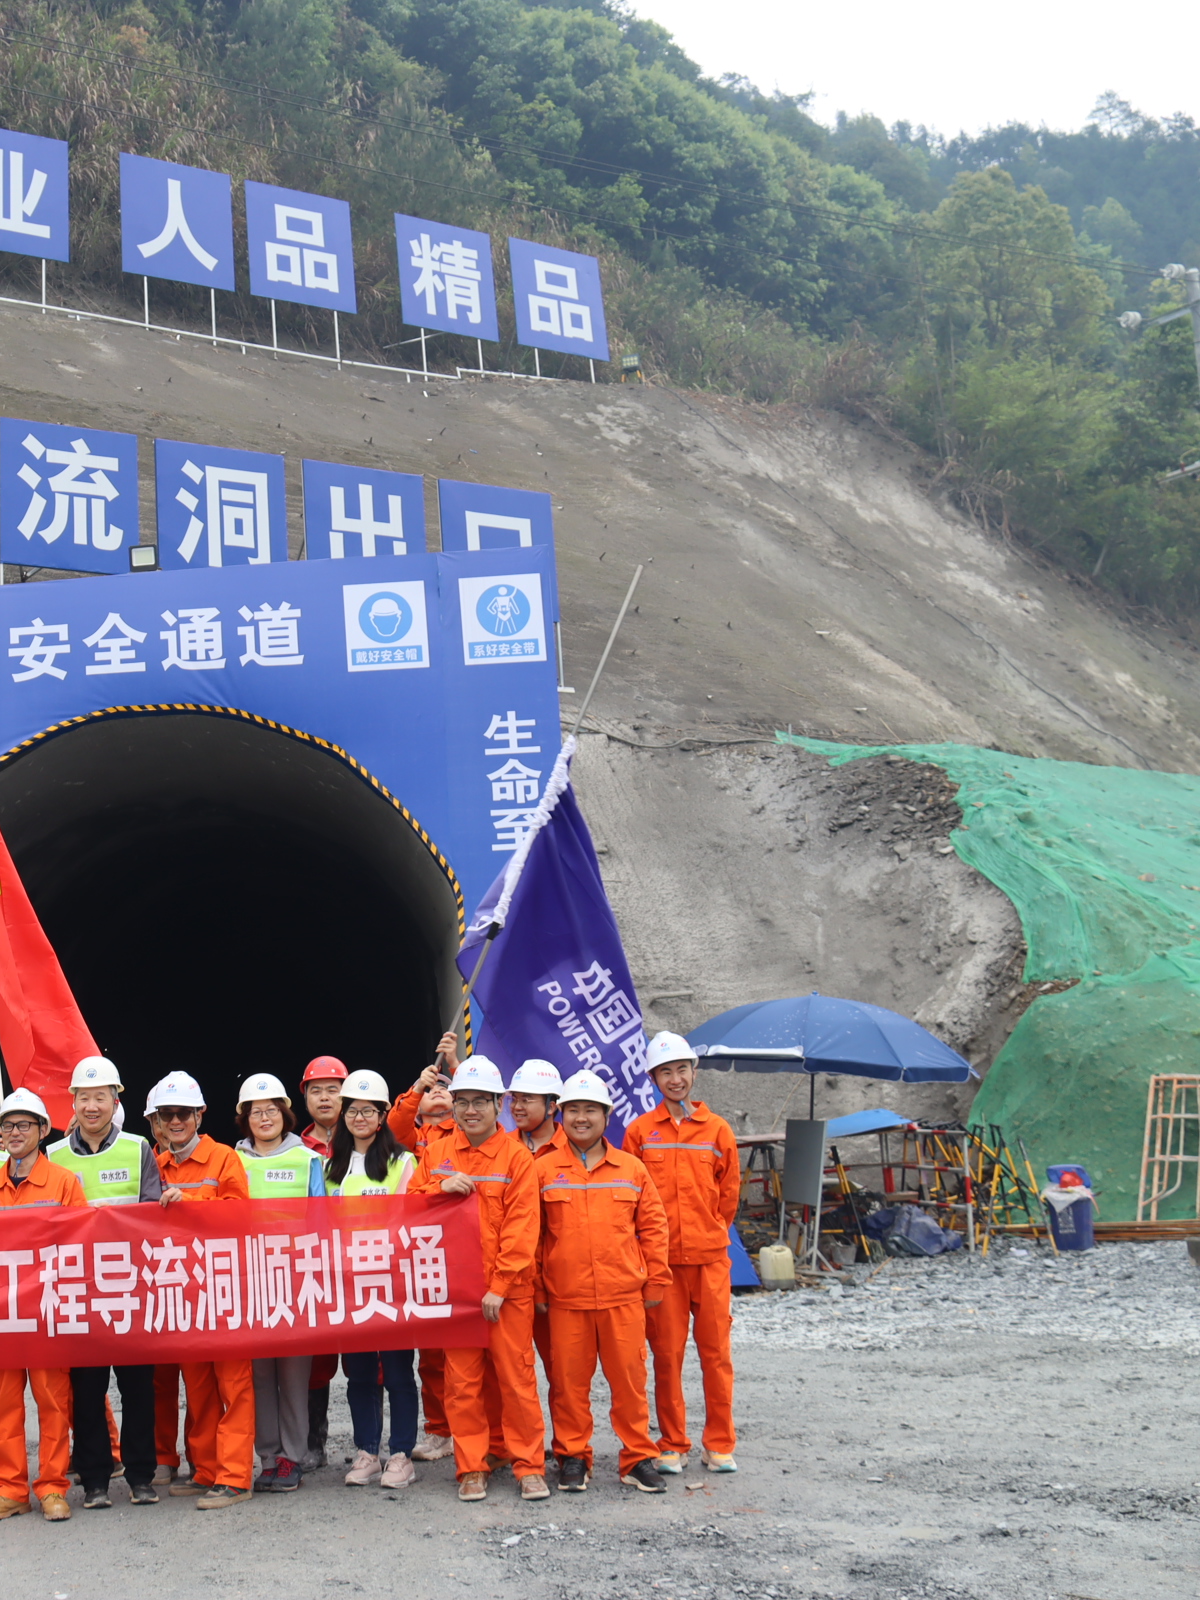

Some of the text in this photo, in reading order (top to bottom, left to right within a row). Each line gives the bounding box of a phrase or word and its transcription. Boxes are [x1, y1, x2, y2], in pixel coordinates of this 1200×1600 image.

[8, 601, 305, 683] 安全通道
[473, 641, 535, 657] 系好安全带
[356, 648, 418, 663] 戴好安全帽
[101, 1168, 129, 1182] 中水北方
[266, 1170, 294, 1181] 中水北方
